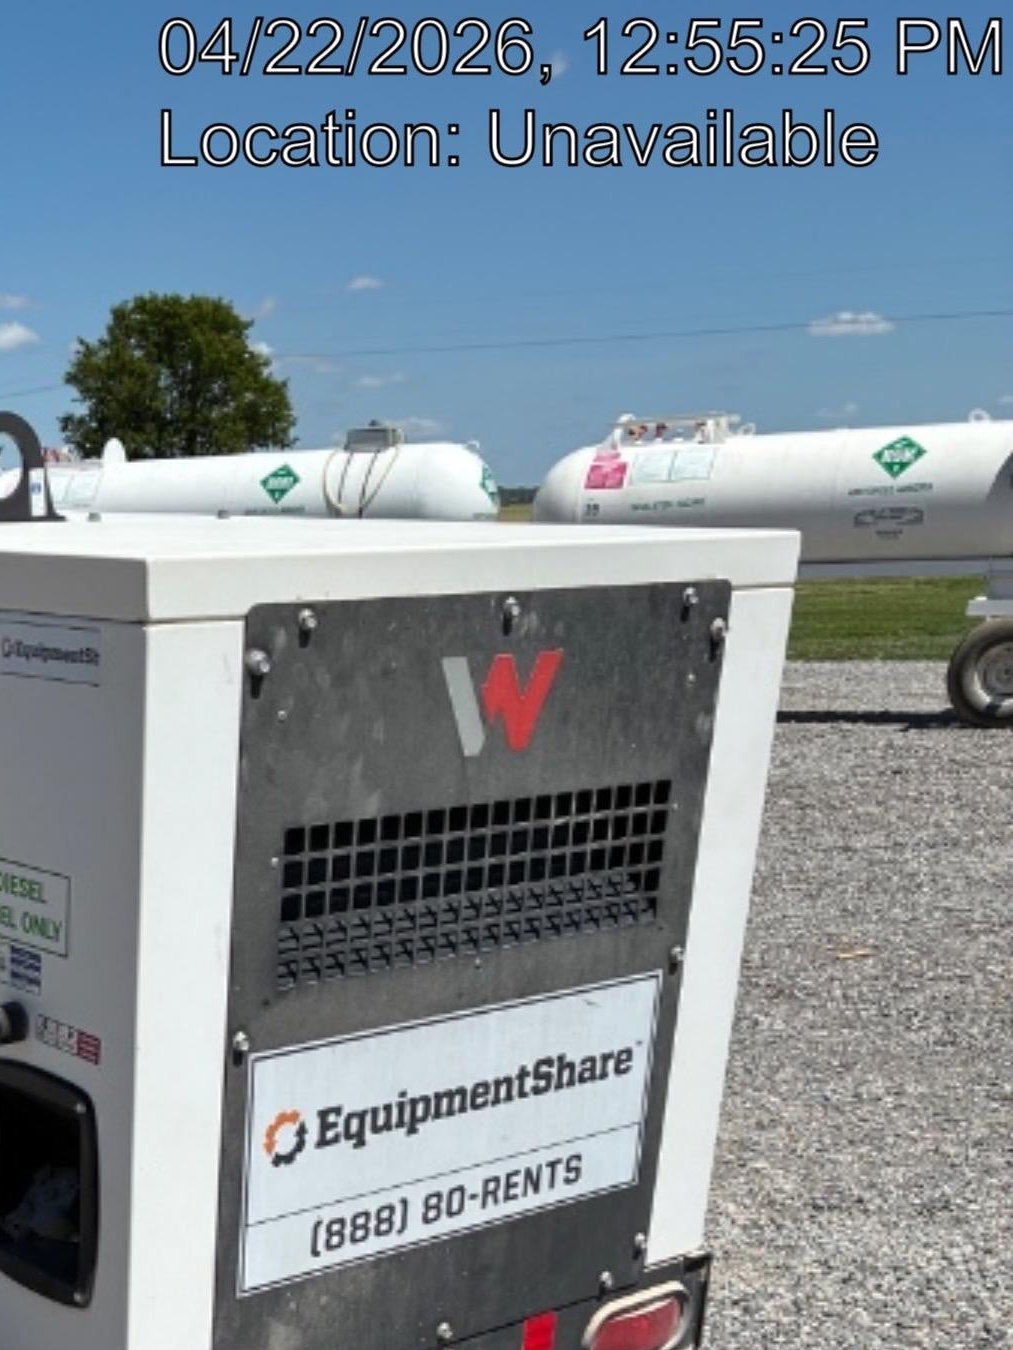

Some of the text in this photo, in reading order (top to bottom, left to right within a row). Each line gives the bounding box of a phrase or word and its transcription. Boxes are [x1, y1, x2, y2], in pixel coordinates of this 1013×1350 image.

[21, 910, 62, 943] ONLY
[315, 1046, 633, 1150] EquipmentShare
[310, 1153, 583, 1258] (888) 80-RENTS
